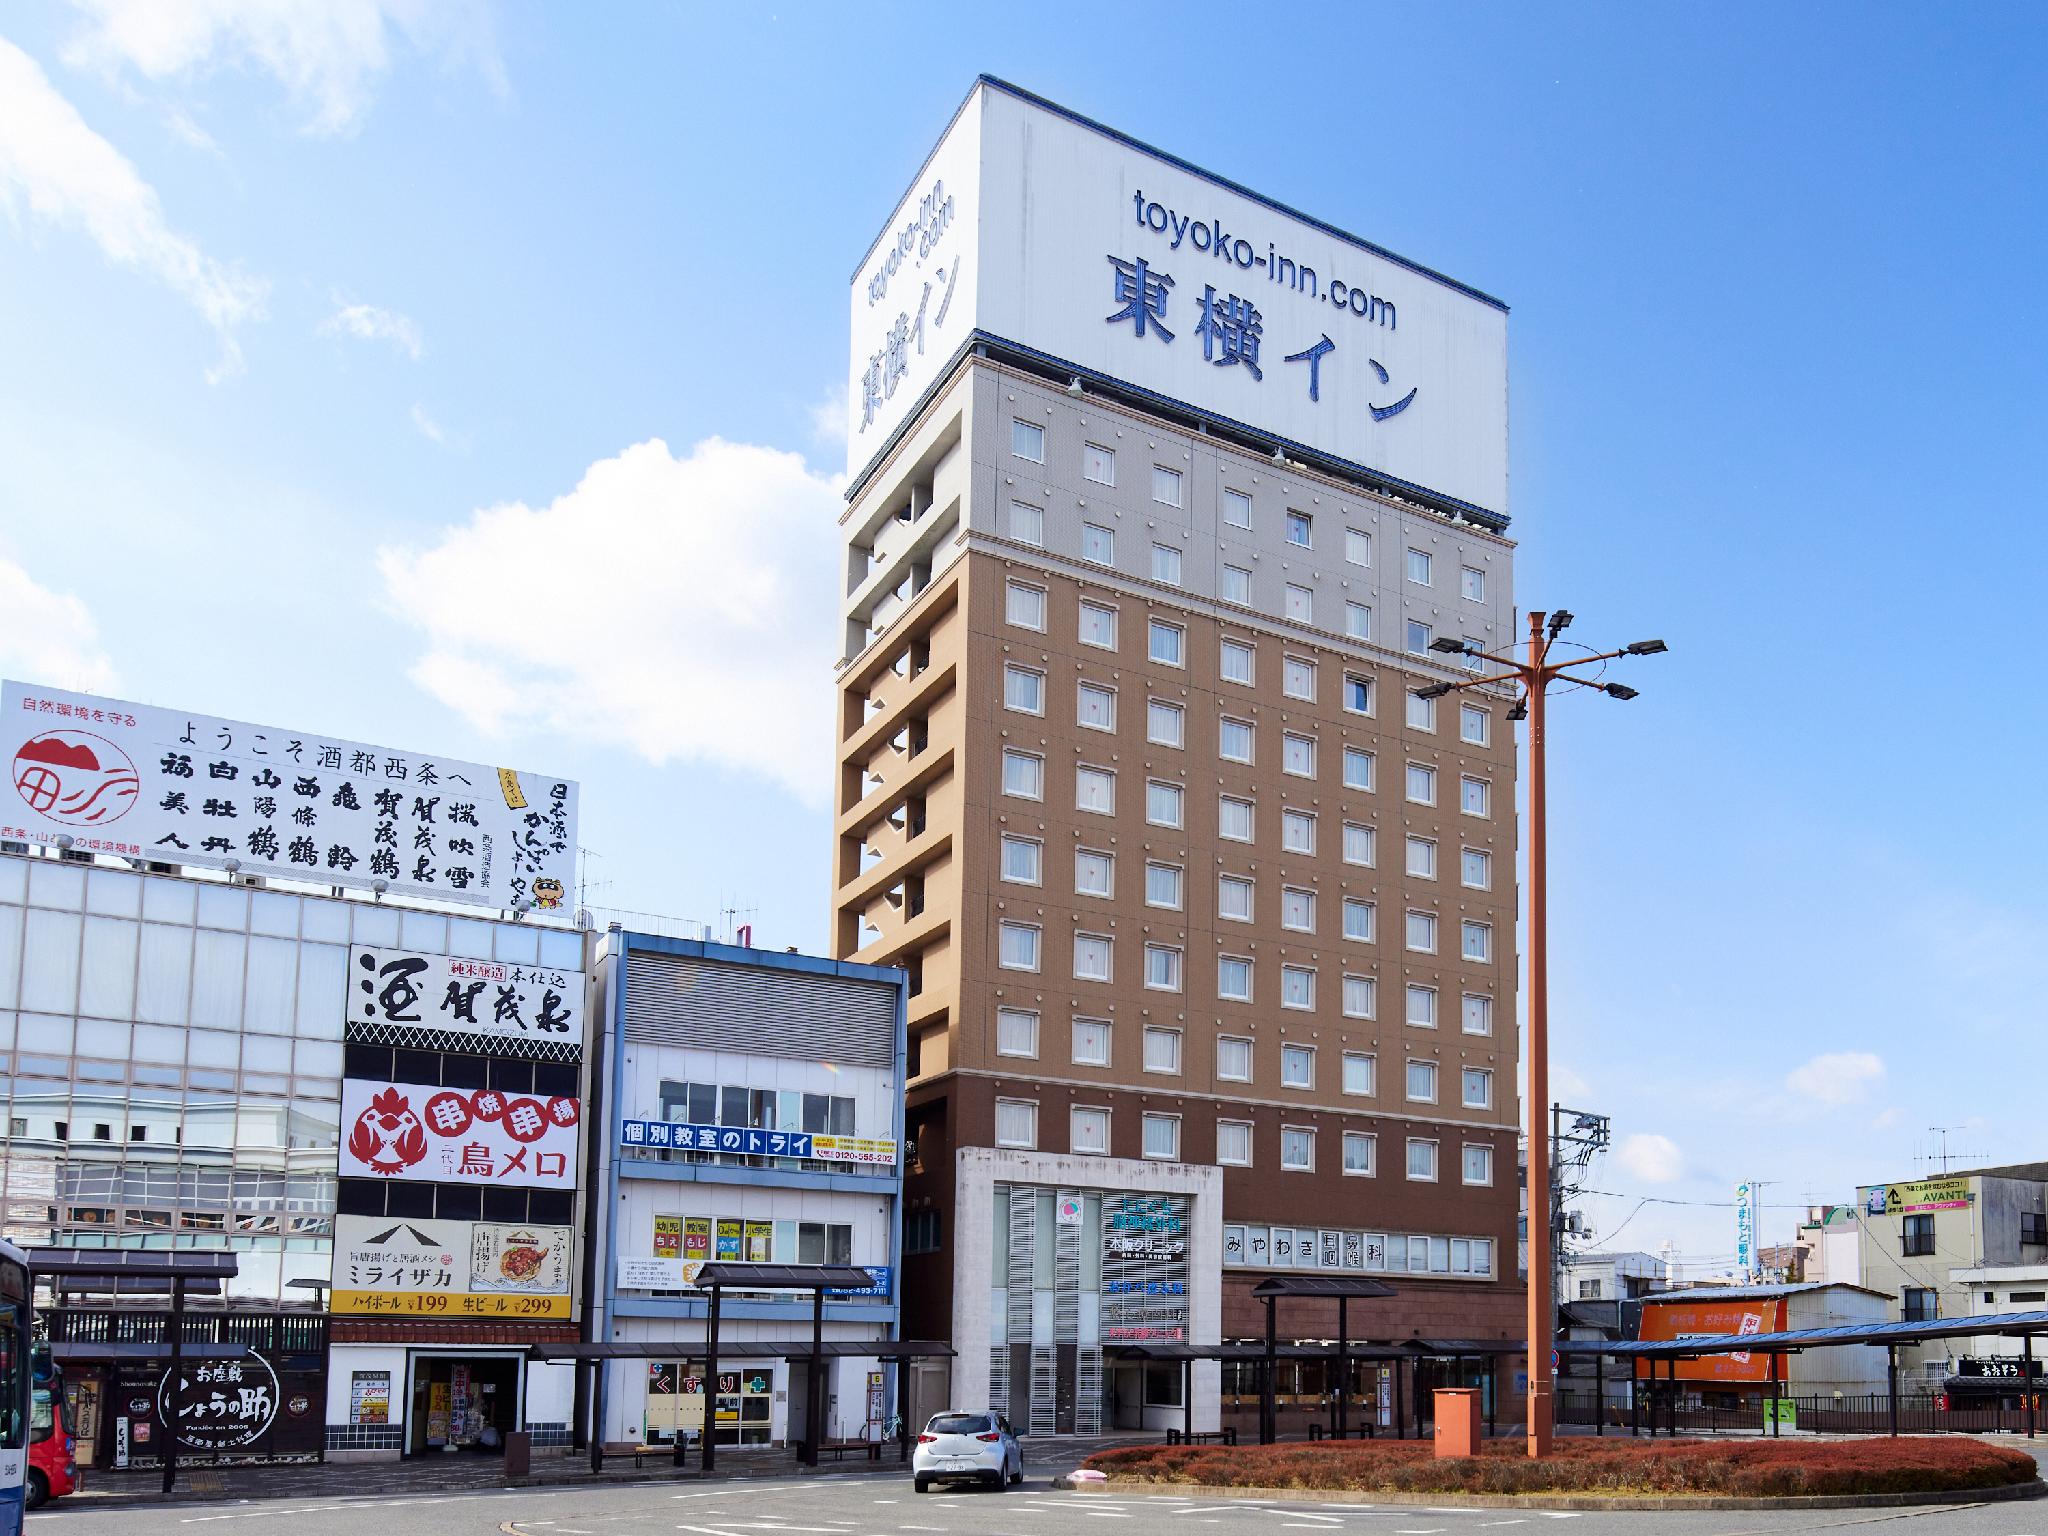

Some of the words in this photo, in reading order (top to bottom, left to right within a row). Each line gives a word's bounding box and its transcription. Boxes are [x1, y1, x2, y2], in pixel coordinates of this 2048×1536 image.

[868, 179, 943, 307] toyoko-inn
[1134, 189, 1397, 330] toyoko-inn.com
[859, 254, 960, 434] 東横イン
[1106, 254, 1418, 422] 東横イン
[23, 697, 137, 727] 自然環境を守る
[180, 721, 472, 787] ようこそ酒都西条へ
[154, 752, 194, 850] 福美人
[200, 760, 239, 854] 白牡丹
[247, 768, 282, 861] 山陽鶴
[1, 826, 140, 856] 西条・山の環境機構
[369, 788, 404, 880] 賀茂鶴
[510, 967, 567, 989] 本仕込
[625, 1122, 811, 1156] 個別教室のトライ
[457, 1142, 567, 1178] 鳥メロ
[1923, 1190, 1967, 1203] AVANTI
[656, 1221, 679, 1232] 幼児
[686, 1222, 708, 1234] 教室
[656, 1236, 678, 1247] ちえ
[686, 1237, 707, 1248] もじ
[718, 1240, 739, 1250] かず
[349, 1265, 452, 1287] ミライザカ
[353, 1295, 401, 1310] ハイボール
[463, 1296, 507, 1312] 生ビール
[657, 1376, 734, 1393] くすり
